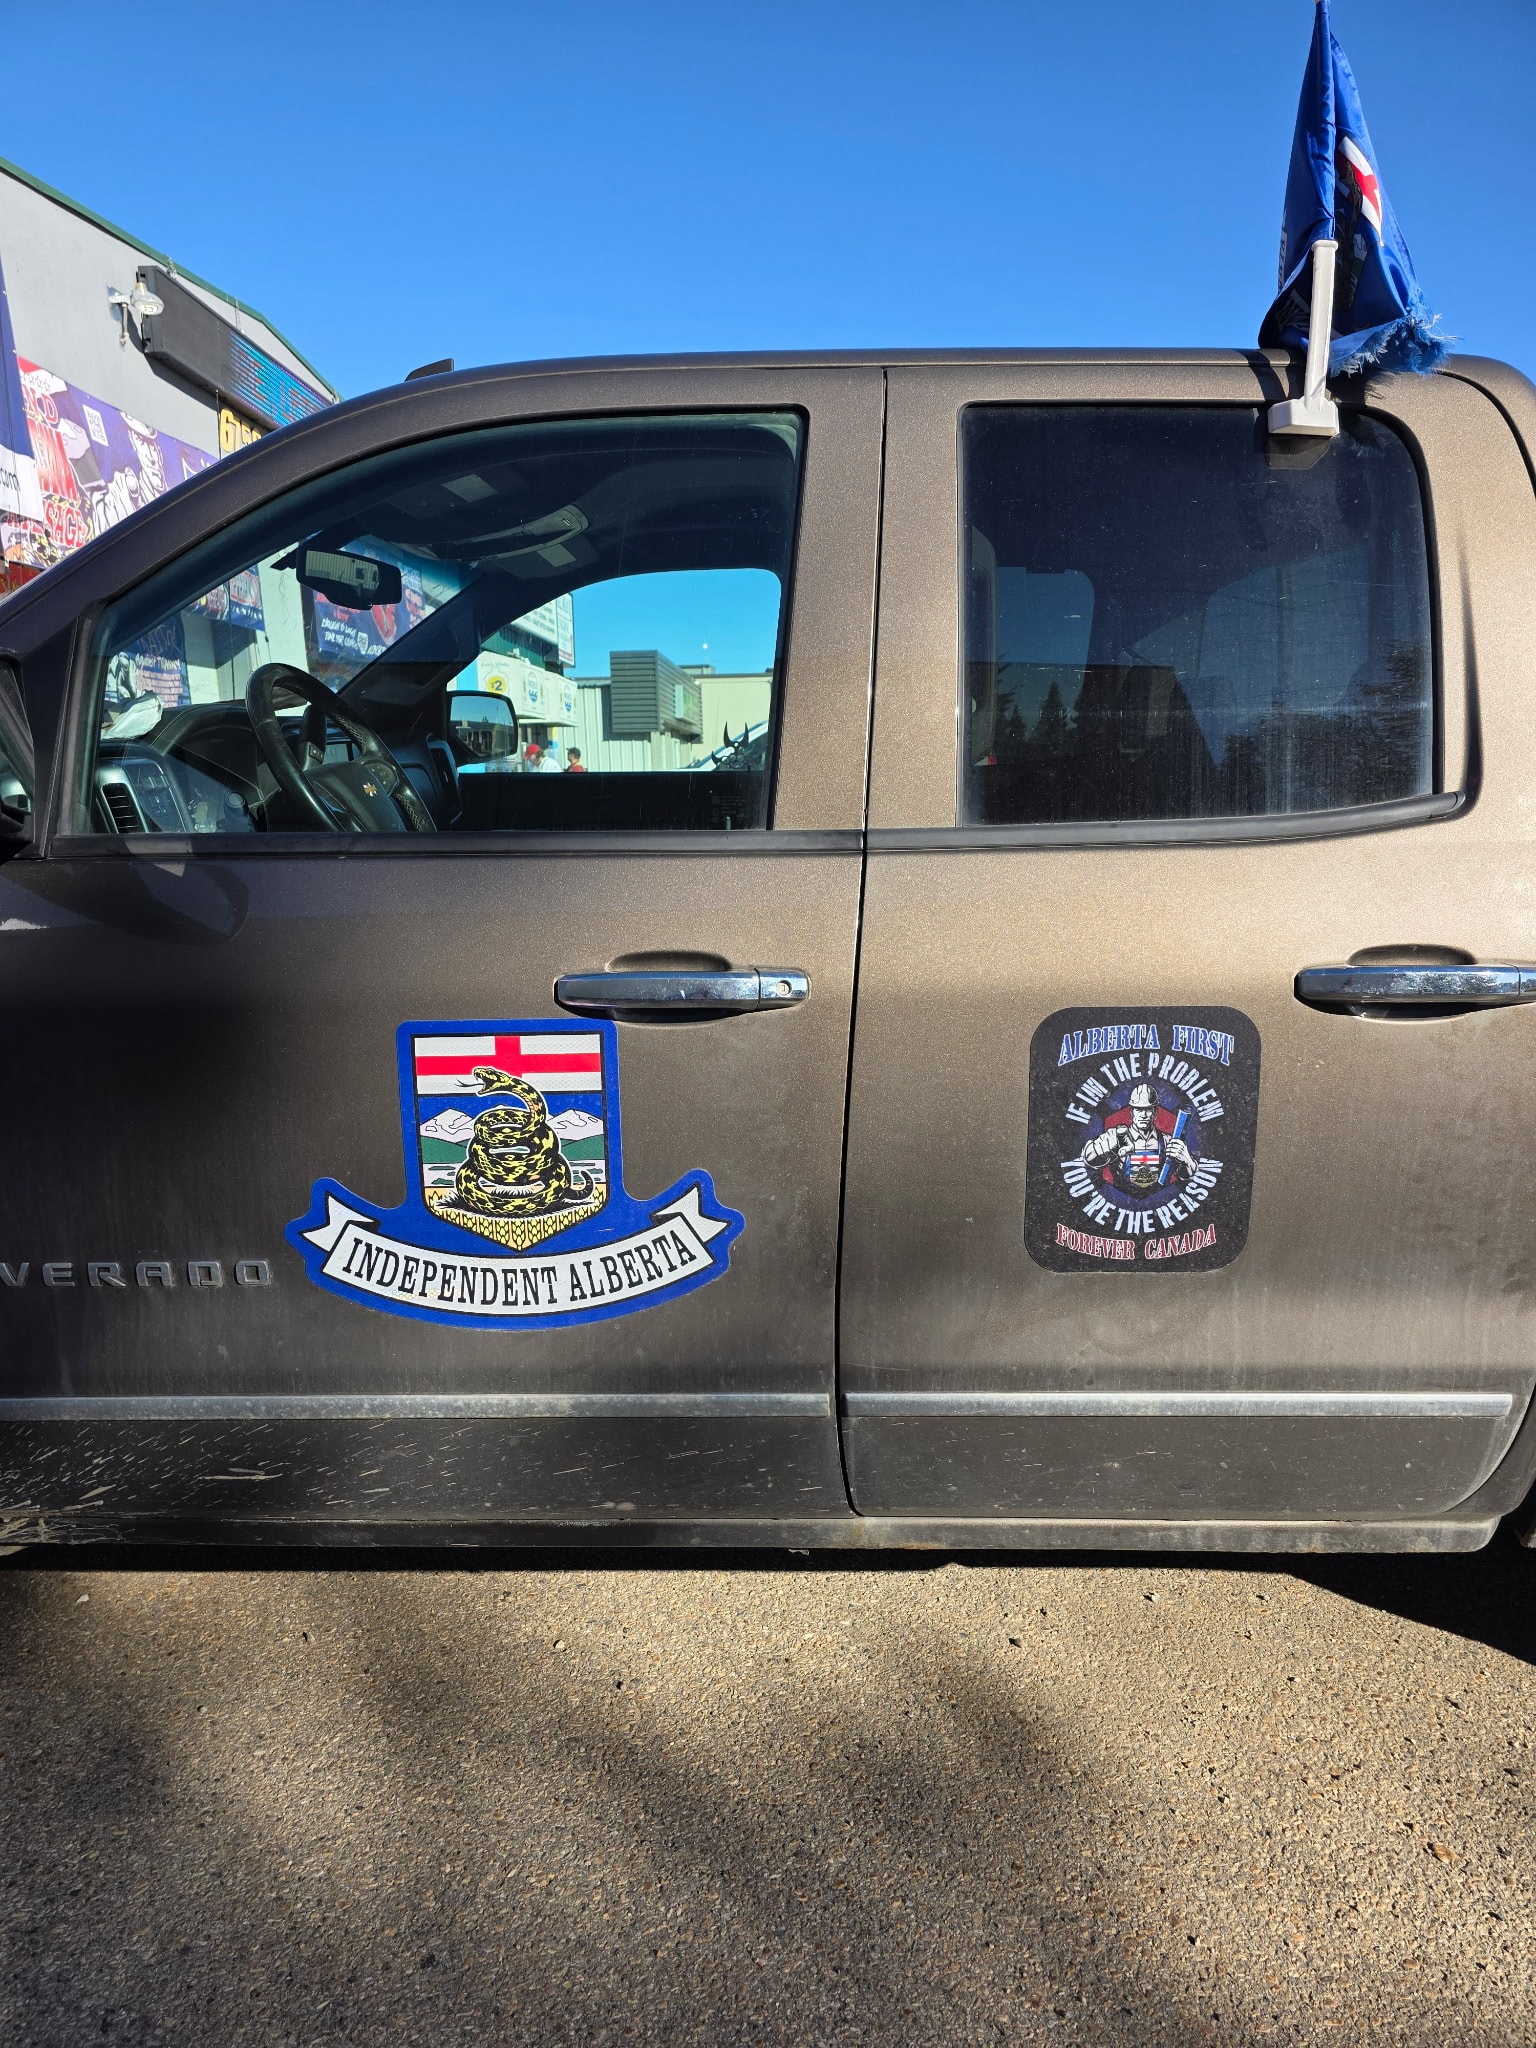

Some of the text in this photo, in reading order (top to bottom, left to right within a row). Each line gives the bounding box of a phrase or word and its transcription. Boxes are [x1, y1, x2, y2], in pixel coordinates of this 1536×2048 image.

[1058, 1023, 1235, 1067] ALBERTA FIRST
[1065, 1102, 1091, 1125] IF
[1100, 1052, 1142, 1087] THE
[1147, 1052, 1225, 1123] PROBLEM
[1060, 1156, 1224, 1234] YOU'RE THE REASON
[342, 1229, 698, 1306] INDEPENDENT ALBERTA
[1055, 1222, 1217, 1260] FOREVER CANADA
[0, 1260, 271, 1288] VERADO
